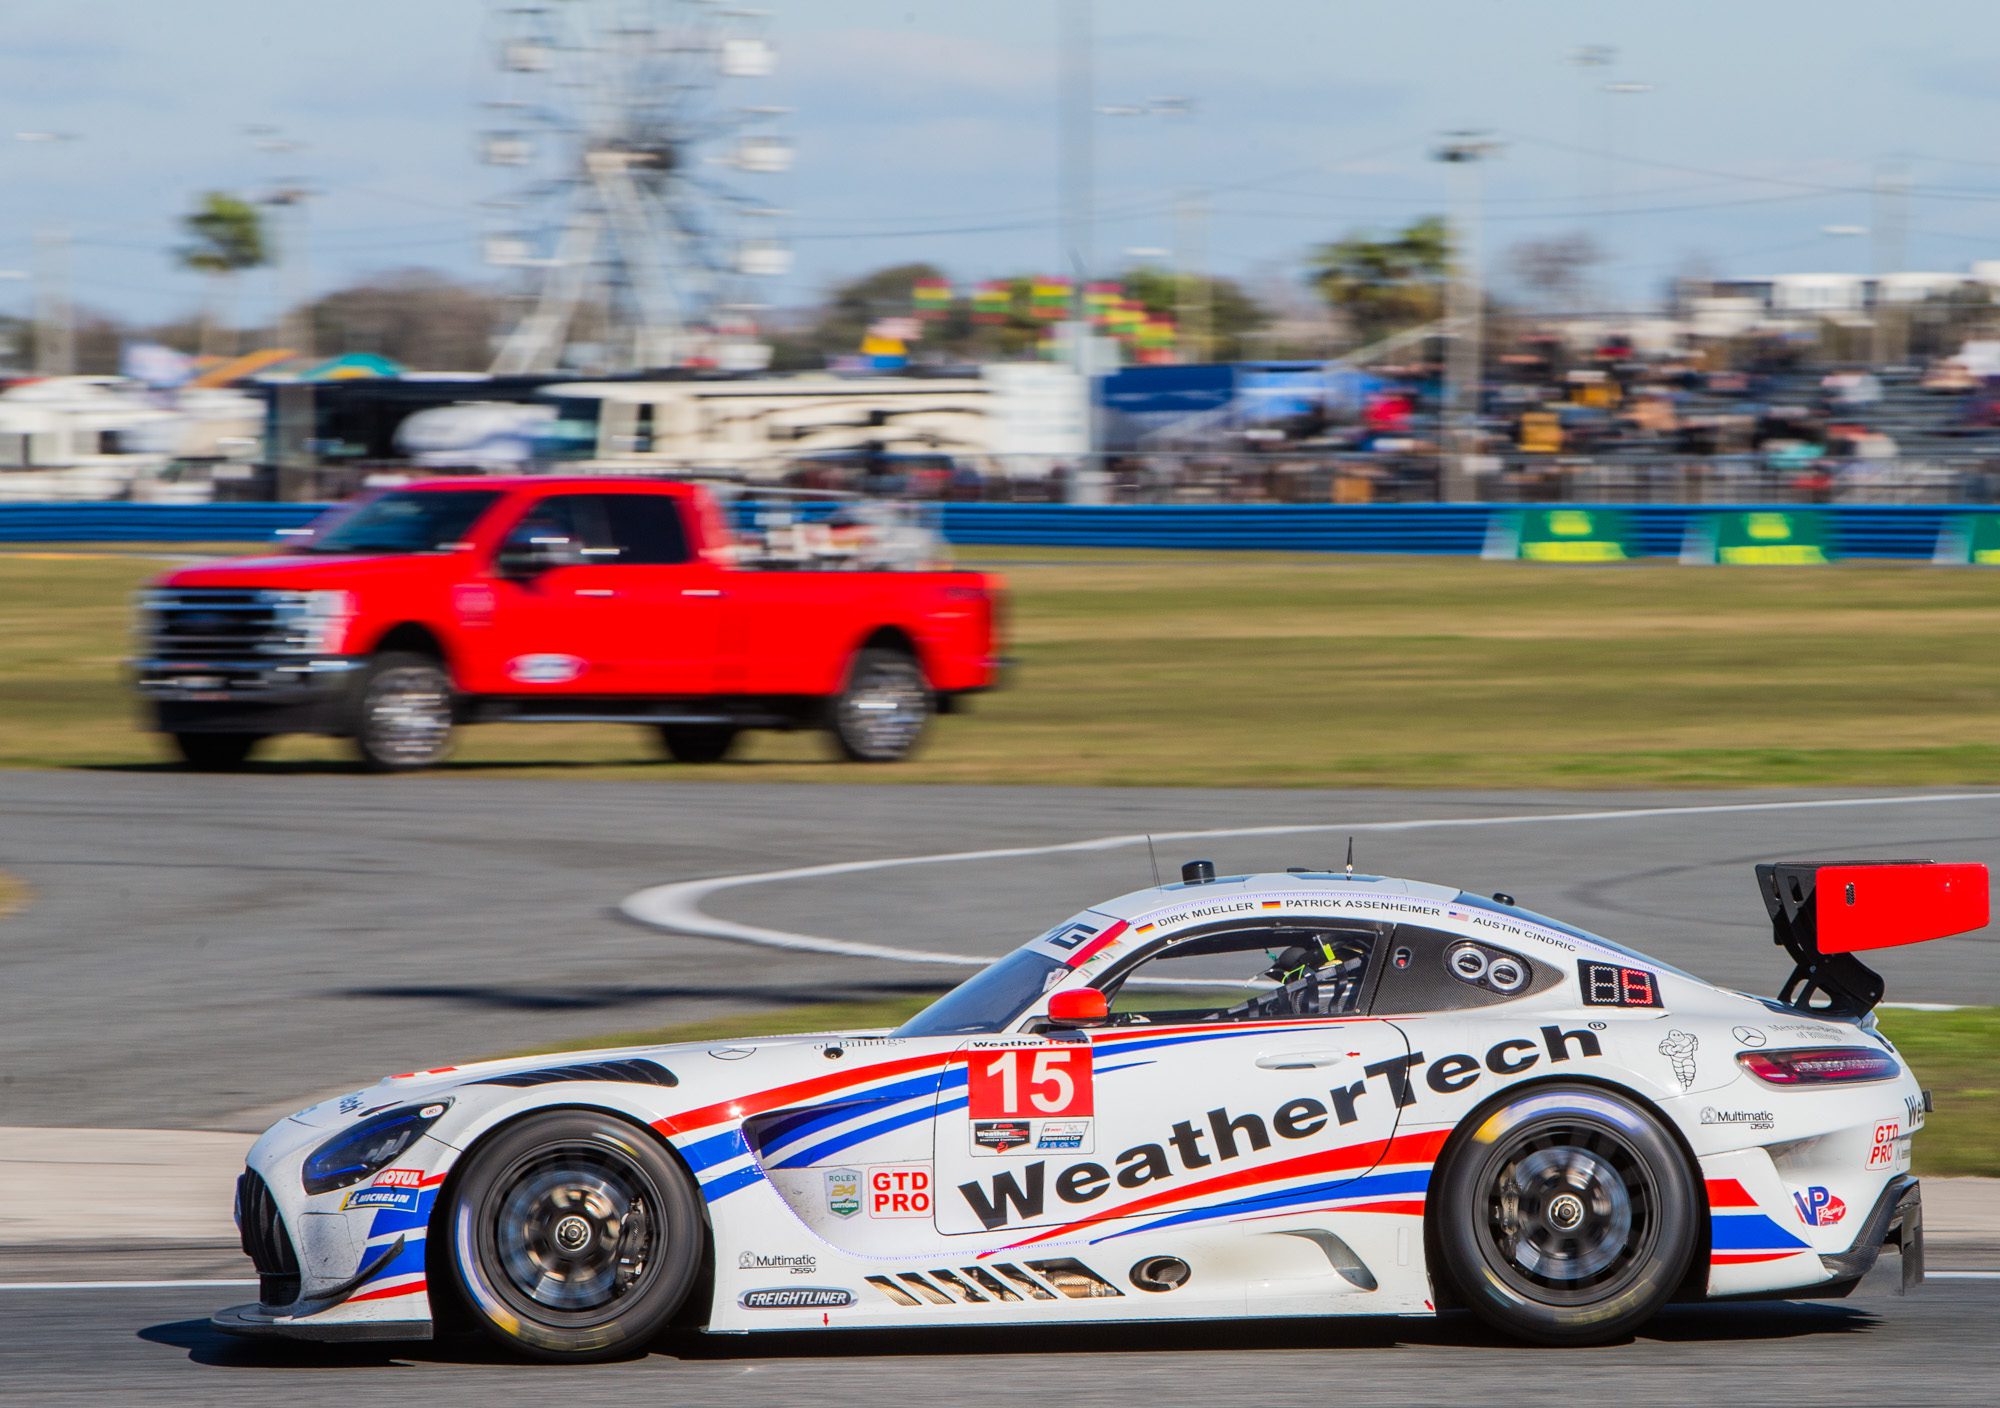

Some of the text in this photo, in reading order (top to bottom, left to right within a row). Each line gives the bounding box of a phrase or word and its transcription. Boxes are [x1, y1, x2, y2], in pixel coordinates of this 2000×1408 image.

[1158, 902, 1255, 927] DIRK MUELLER
[1286, 899, 1440, 916] PATRICK ASSENHEIMER
[1473, 917, 1576, 952] AUSTIN CINDRIC
[987, 1051, 1074, 1113] 15
[1717, 1111, 1774, 1122] Multimatic
[1875, 1124, 1899, 1144] GTD
[1870, 1143, 1893, 1164] PRO
[375, 1170, 421, 1186] MOTUL
[873, 1172, 928, 1191] GTD
[357, 1191, 410, 1204] MICHELIN
[831, 1184, 856, 1197] 24
[874, 1193, 930, 1212] PRO
[1793, 1186, 1830, 1226] VP
[756, 1254, 816, 1267] Multimatic
[748, 1291, 847, 1305] FREIGHTLINER
